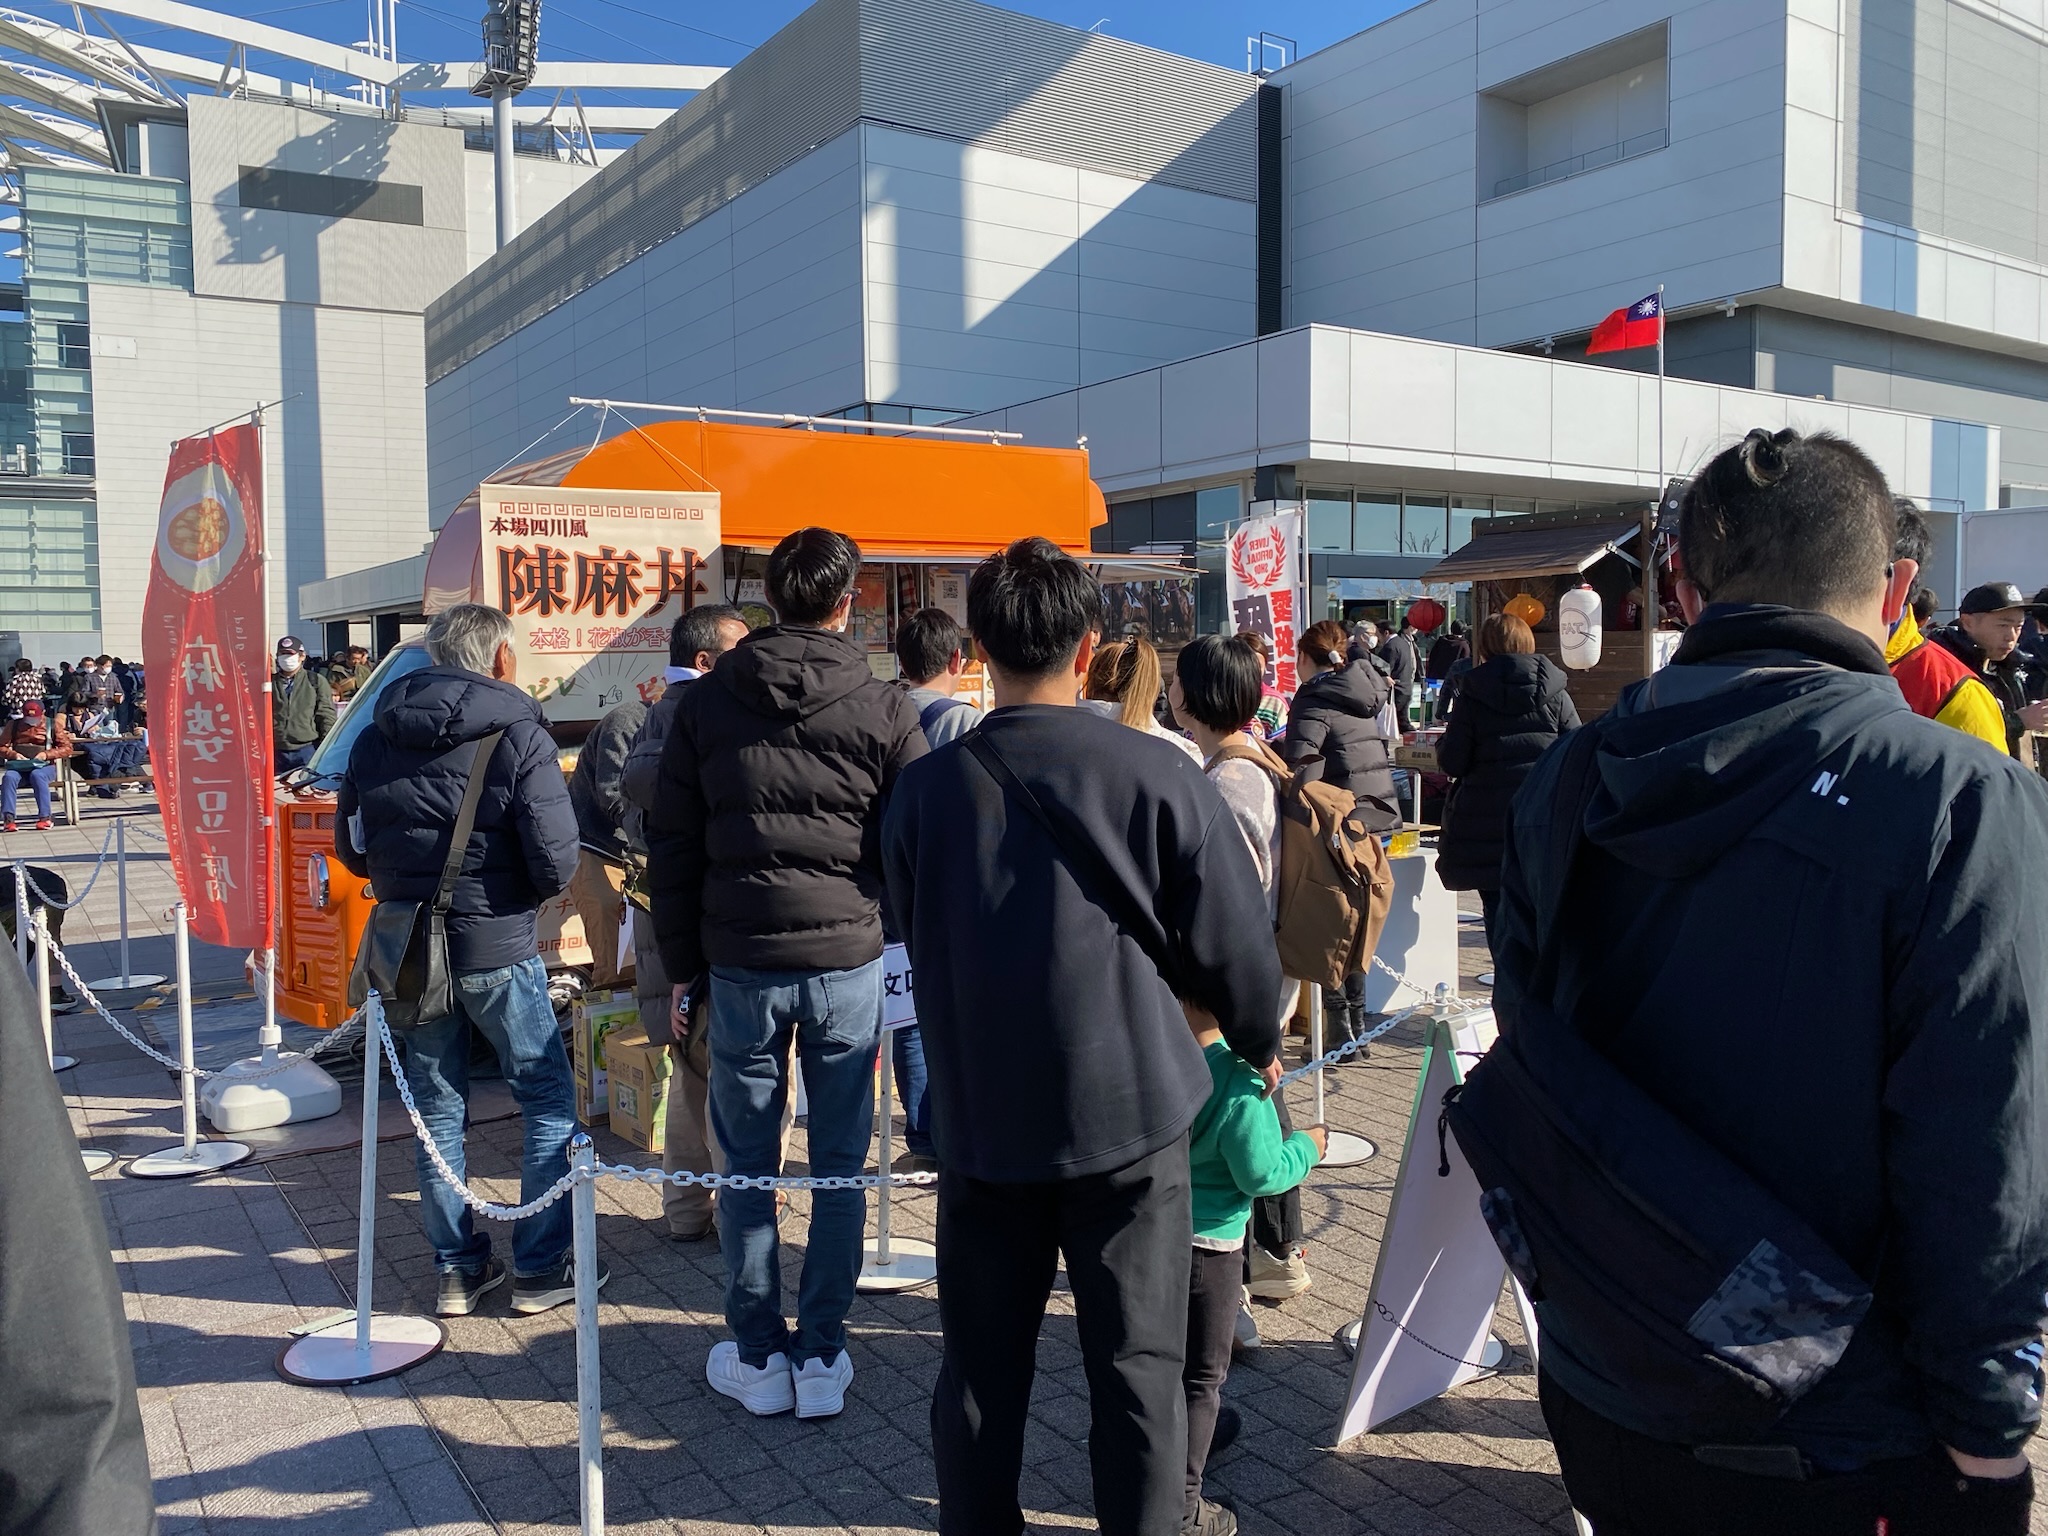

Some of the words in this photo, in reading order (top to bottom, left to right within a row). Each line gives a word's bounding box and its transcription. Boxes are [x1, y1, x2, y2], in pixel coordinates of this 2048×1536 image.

[489, 517, 589, 538] 本場四川風
[496, 543, 708, 618] 陳麻丼
